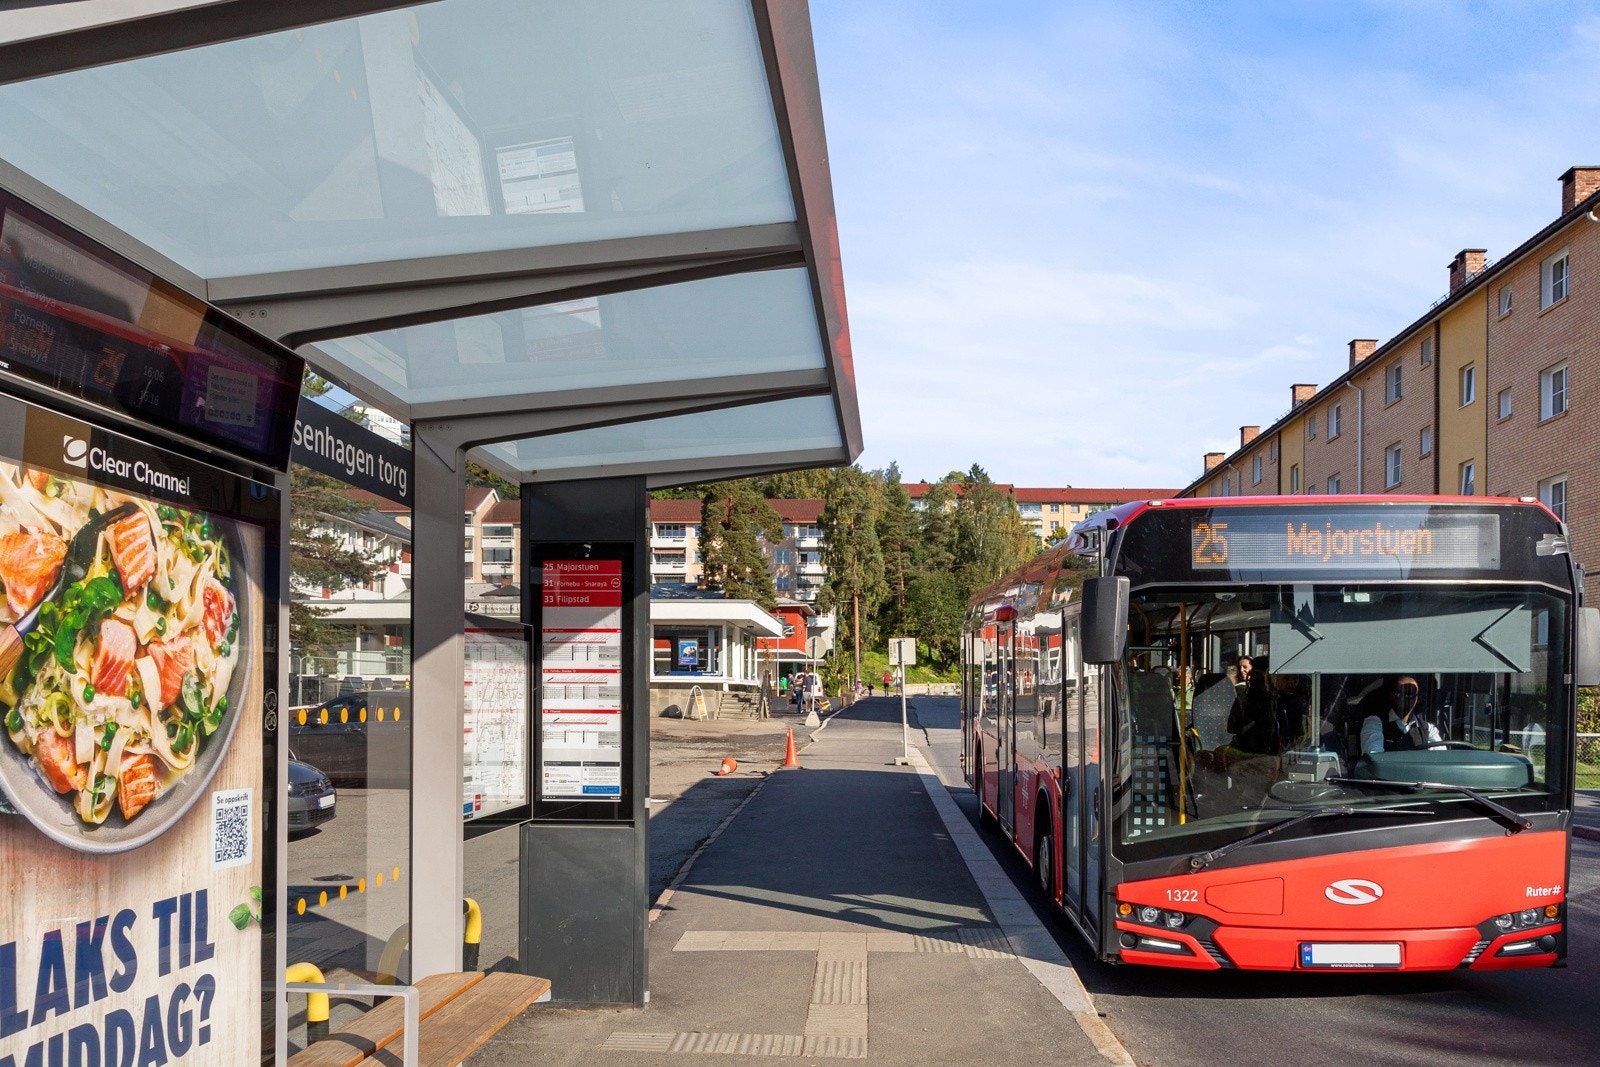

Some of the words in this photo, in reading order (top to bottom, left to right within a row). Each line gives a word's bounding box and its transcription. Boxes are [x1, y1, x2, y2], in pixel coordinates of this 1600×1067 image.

[23, 253, 75, 287] Majorstuen
[14, 309, 54, 335] Fornebu
[89, 447, 131, 478] Clear
[133, 461, 190, 496] Channel
[378, 454, 407, 497] torg
[1193, 523, 1229, 563] 25
[1286, 522, 1432, 562] Majorstuen
[543, 563, 554, 571] 25
[556, 563, 599, 572] Majorstuen
[544, 579, 554, 587] 31
[584, 580, 608, 588] Snarøya
[544, 595, 554, 603] 33
[557, 595, 590, 604] Filipstad
[216, 796, 224, 804] Se
[1166, 889, 1199, 902] 1322
[1526, 885, 1562, 897] Ruter#
[0, 908, 138, 1039] LAKS
[152, 888, 215, 978] TIL
